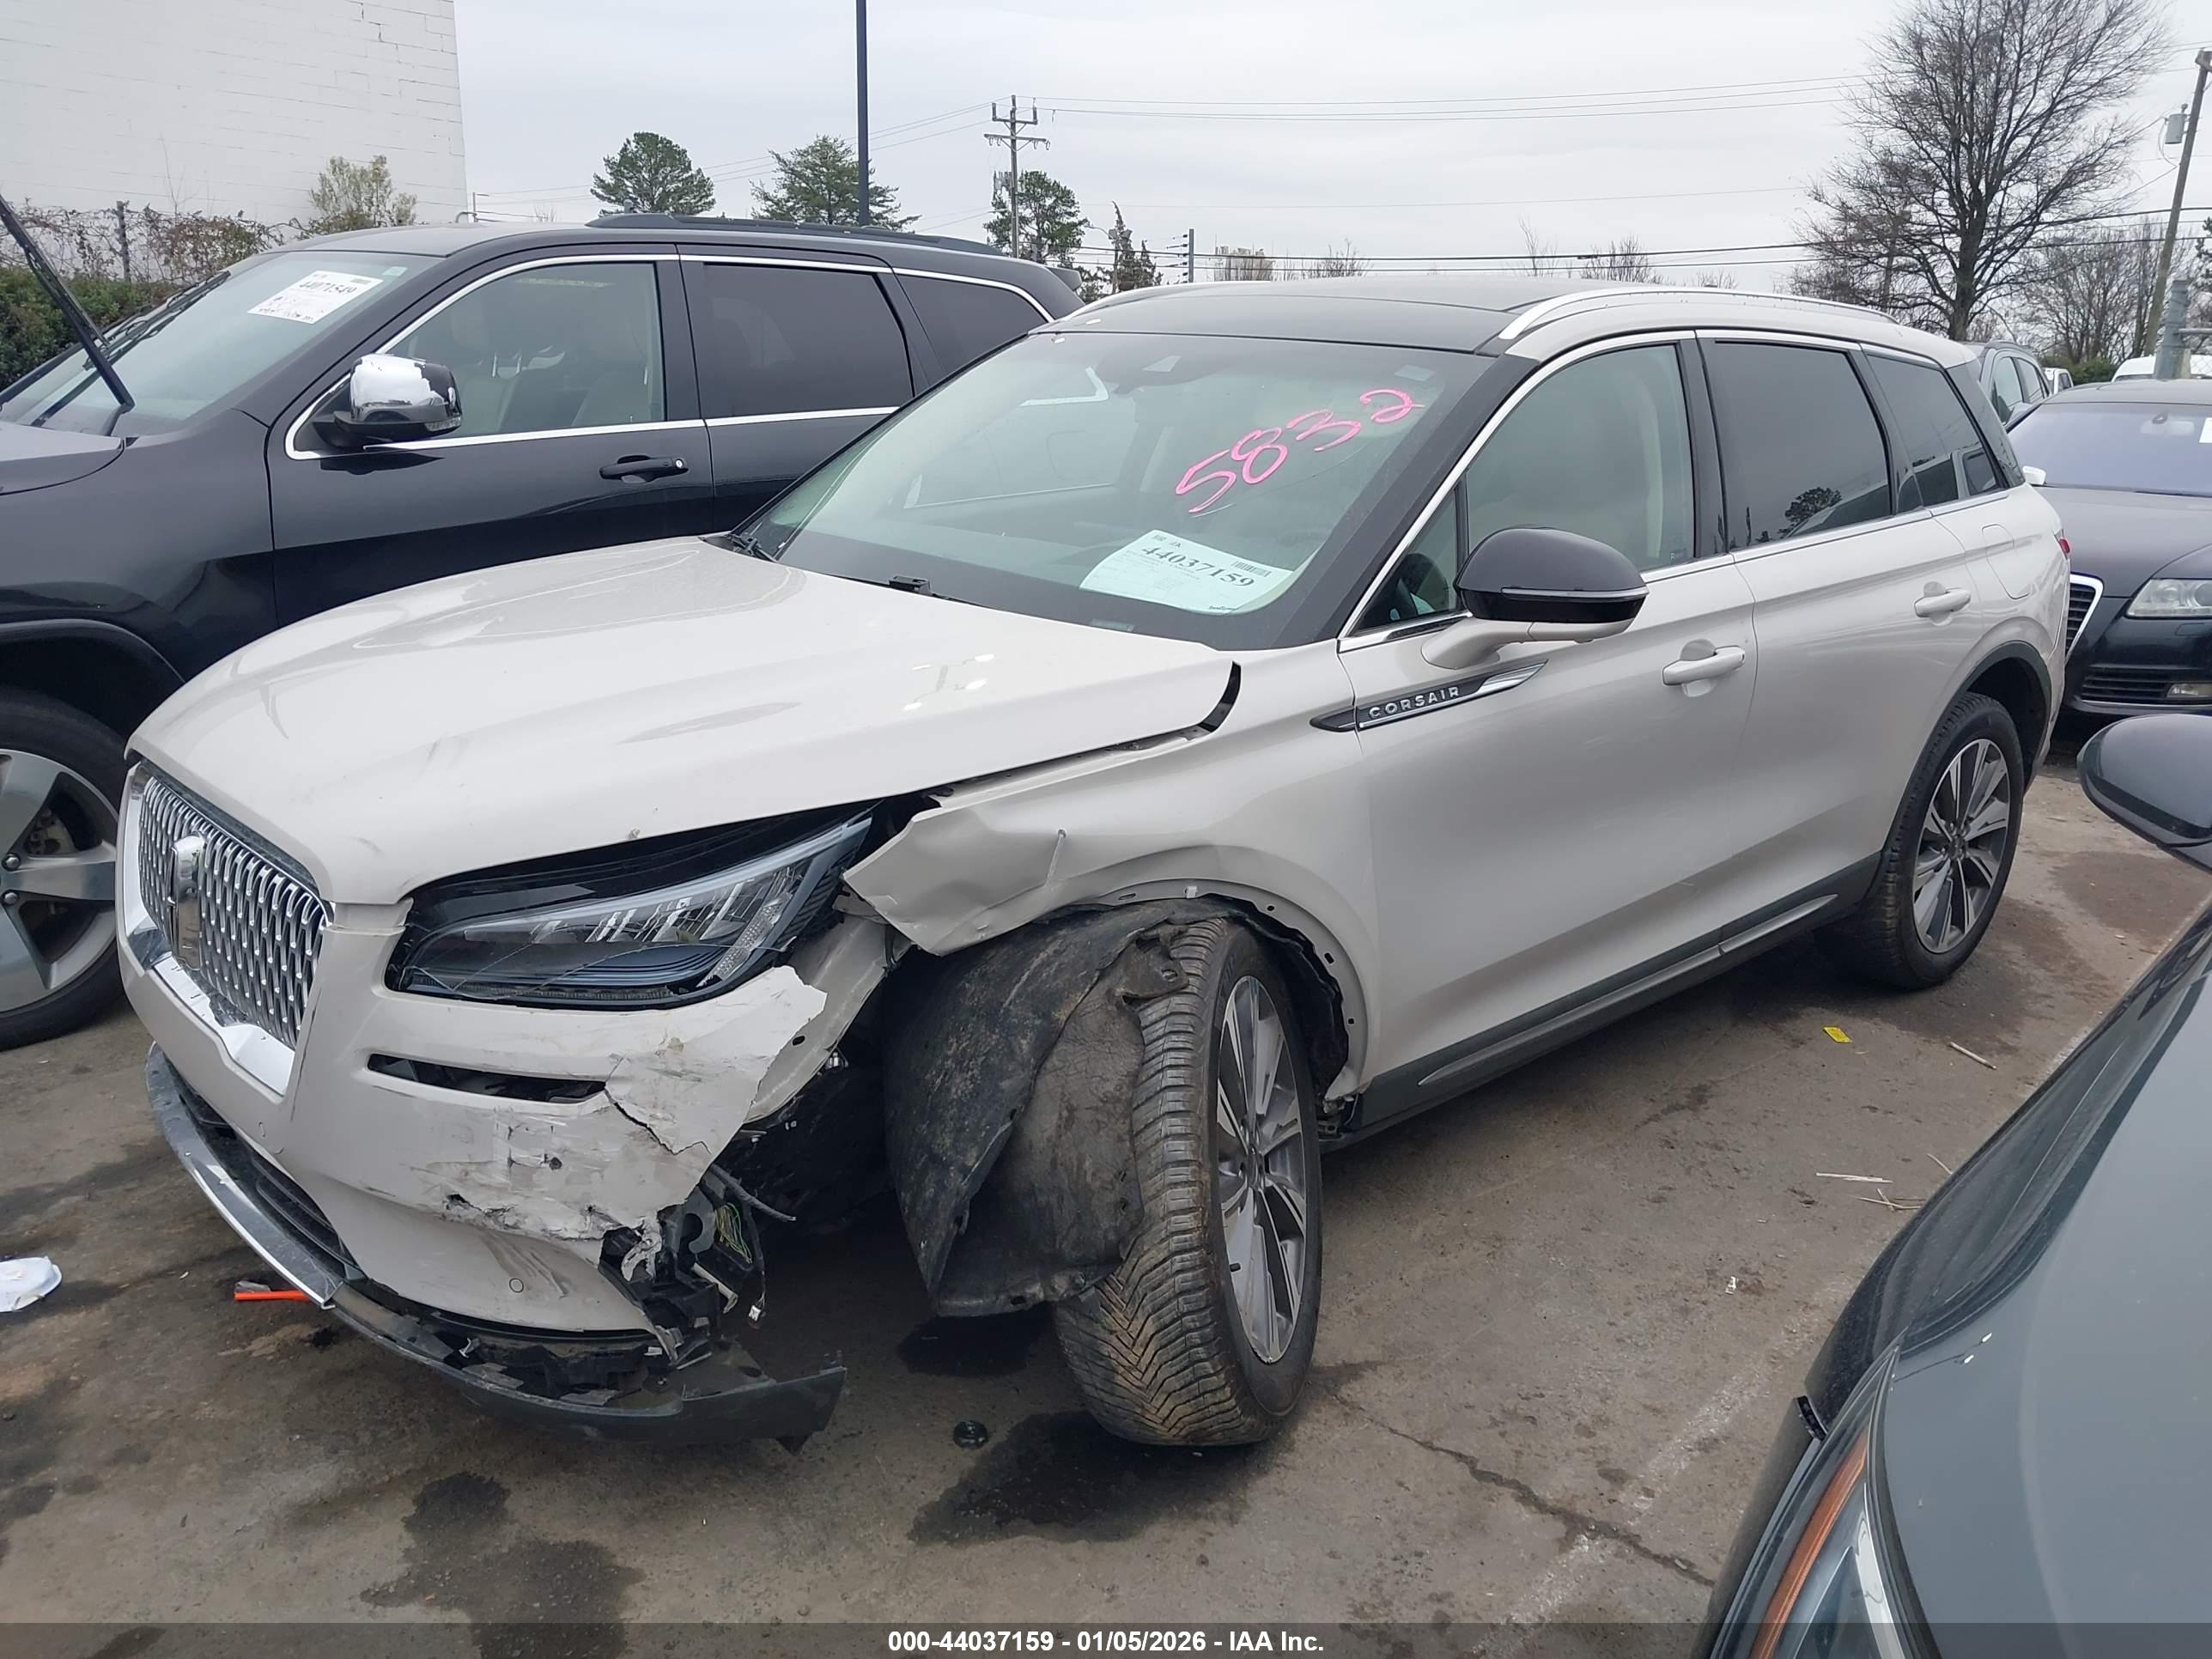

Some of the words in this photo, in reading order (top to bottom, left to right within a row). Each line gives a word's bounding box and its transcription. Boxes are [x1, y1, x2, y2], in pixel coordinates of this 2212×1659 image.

[1176, 389, 1425, 514] 5832
[1142, 546, 1255, 586] 44037159
[1369, 685, 1460, 720] CORSAIR
